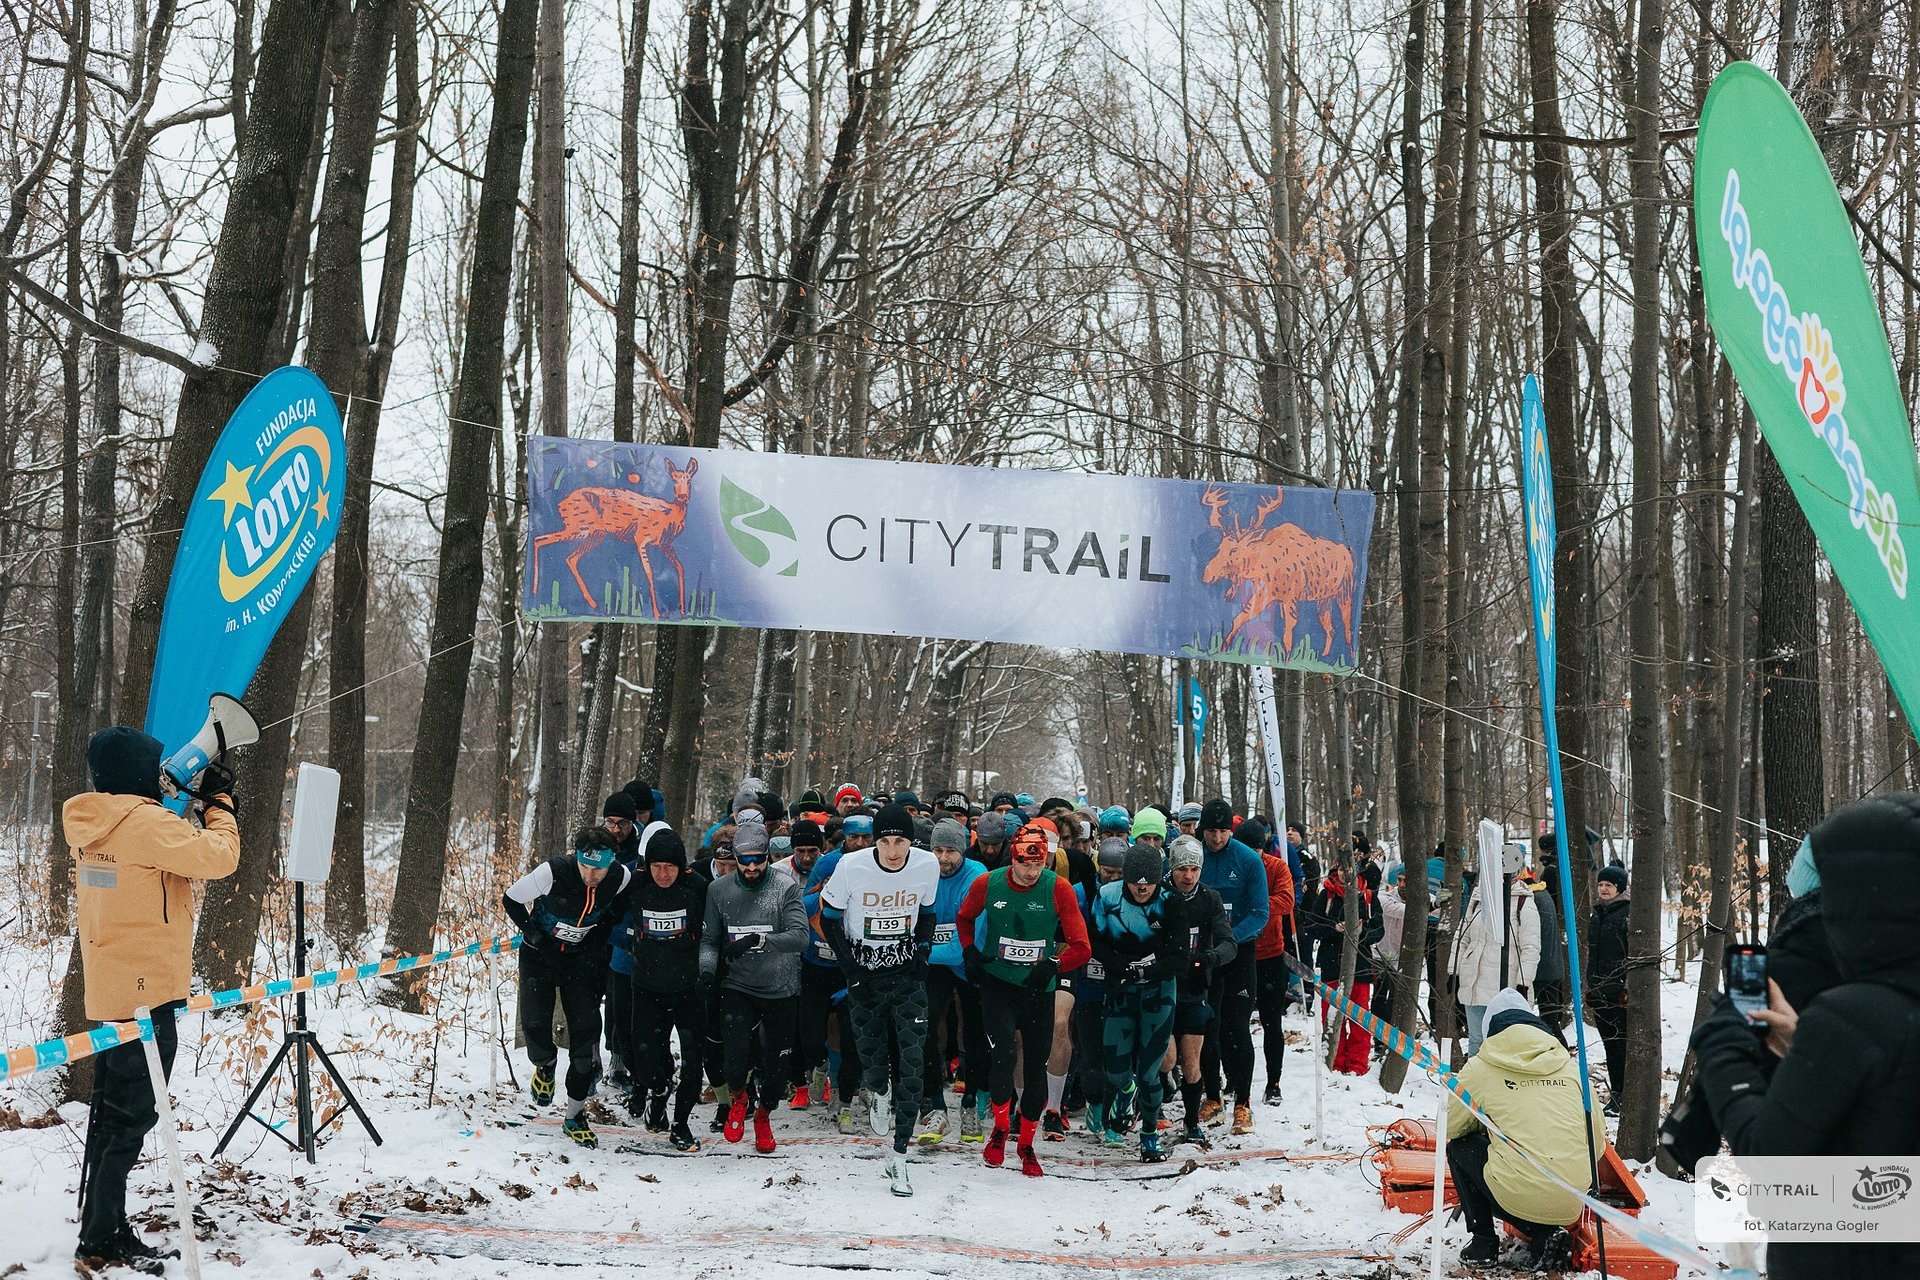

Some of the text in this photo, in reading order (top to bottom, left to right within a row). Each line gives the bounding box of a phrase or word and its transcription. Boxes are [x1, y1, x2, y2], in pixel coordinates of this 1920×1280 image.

[255, 397, 317, 456] FUNDACJA
[235, 452, 310, 568] LOTTO
[242, 608, 257, 626] H.
[1192, 695, 1203, 720] 5
[862, 889, 918, 908] Delia
[653, 920, 676, 930] 1121
[877, 919, 899, 930] 139
[1008, 947, 1034, 957] 302
